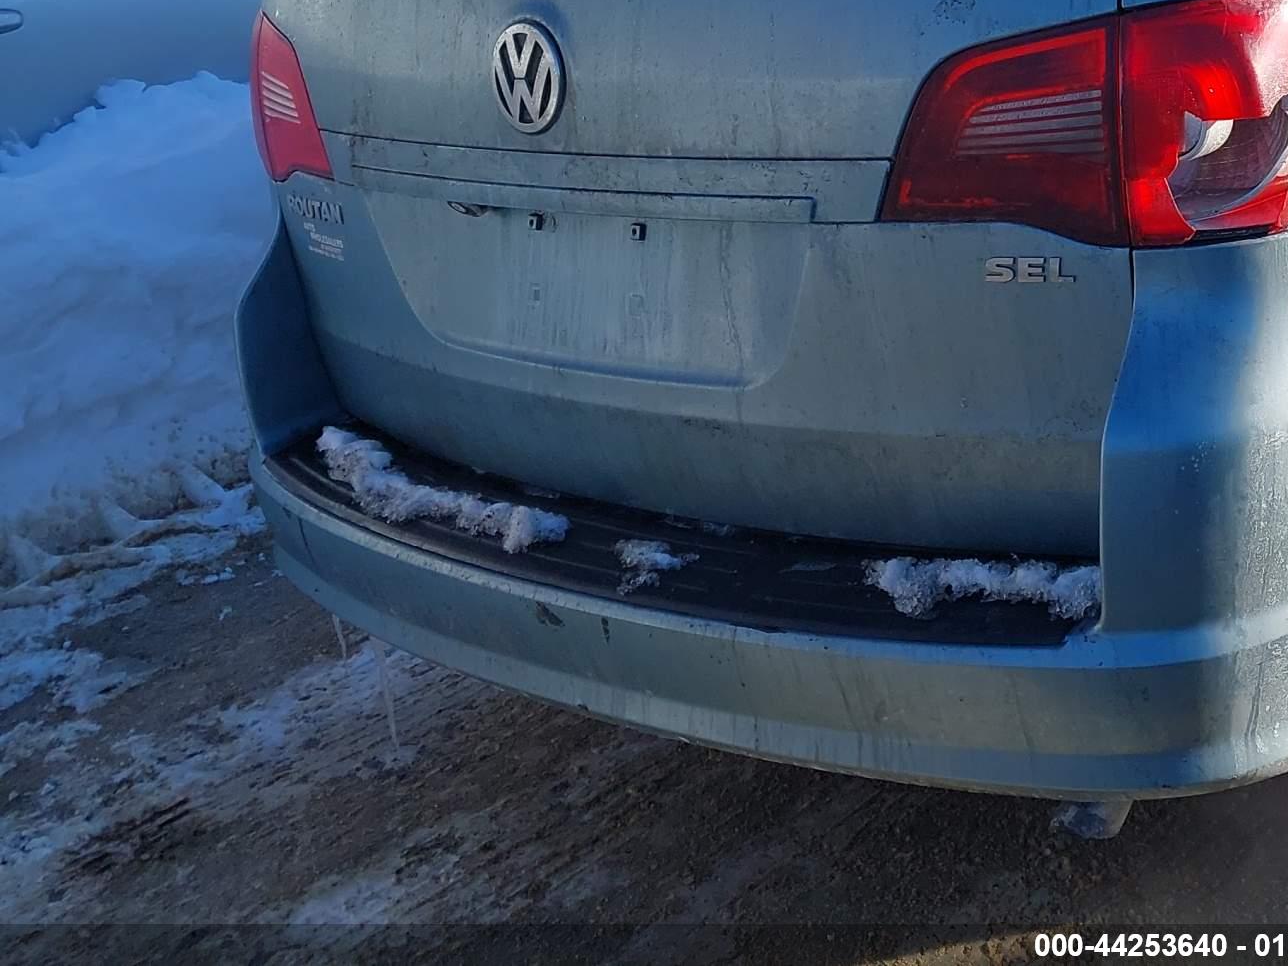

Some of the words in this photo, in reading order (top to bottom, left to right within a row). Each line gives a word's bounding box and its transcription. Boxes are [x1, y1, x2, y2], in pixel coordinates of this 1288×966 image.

[493, 22, 561, 133] VW
[286, 194, 344, 225] ROUTAN
[984, 256, 1076, 283] SEL
